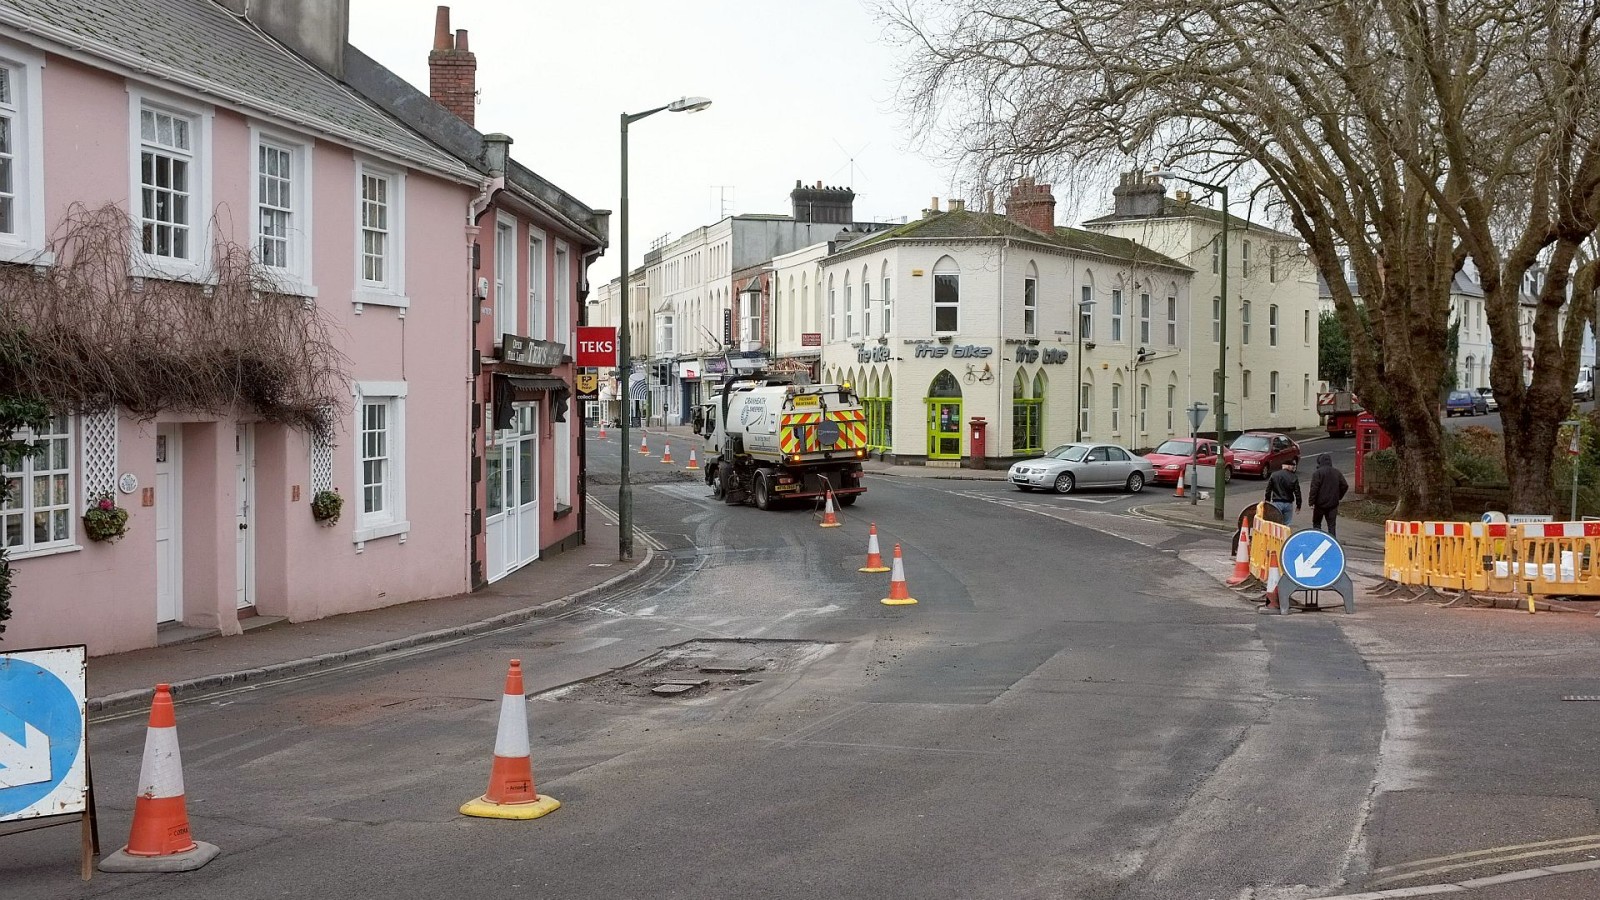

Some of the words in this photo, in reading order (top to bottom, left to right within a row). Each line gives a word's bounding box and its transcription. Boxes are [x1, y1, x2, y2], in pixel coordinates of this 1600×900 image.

[580, 341, 612, 352] TEKS
[915, 344, 948, 358] the
[952, 344, 993, 358] bike
[1015, 345, 1039, 363] the
[1042, 347, 1069, 364] bike
